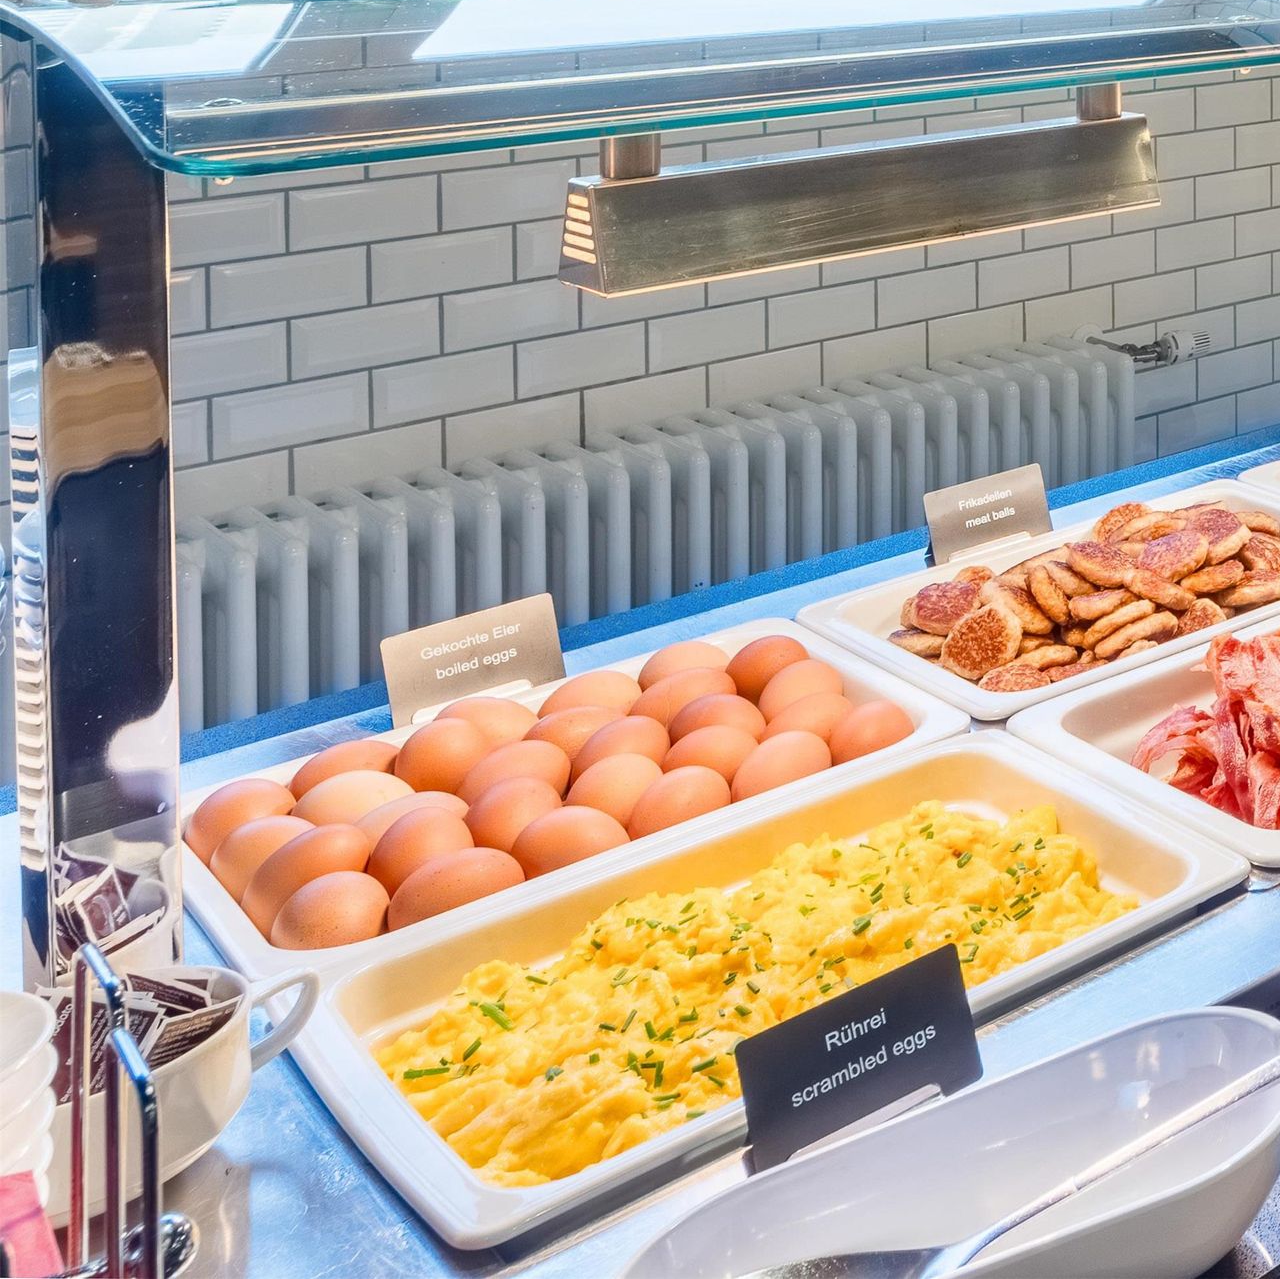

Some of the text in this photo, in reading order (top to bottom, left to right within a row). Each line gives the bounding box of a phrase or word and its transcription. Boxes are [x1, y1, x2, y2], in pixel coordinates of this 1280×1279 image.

[958, 488, 1013, 511] Frikadellen
[965, 506, 1016, 528] meat balls
[420, 622, 521, 660] Gekochte Eier
[435, 646, 518, 680] boiled eggs
[824, 1008, 887, 1052] Rührei
[791, 1024, 937, 1108] scrambled eggs
